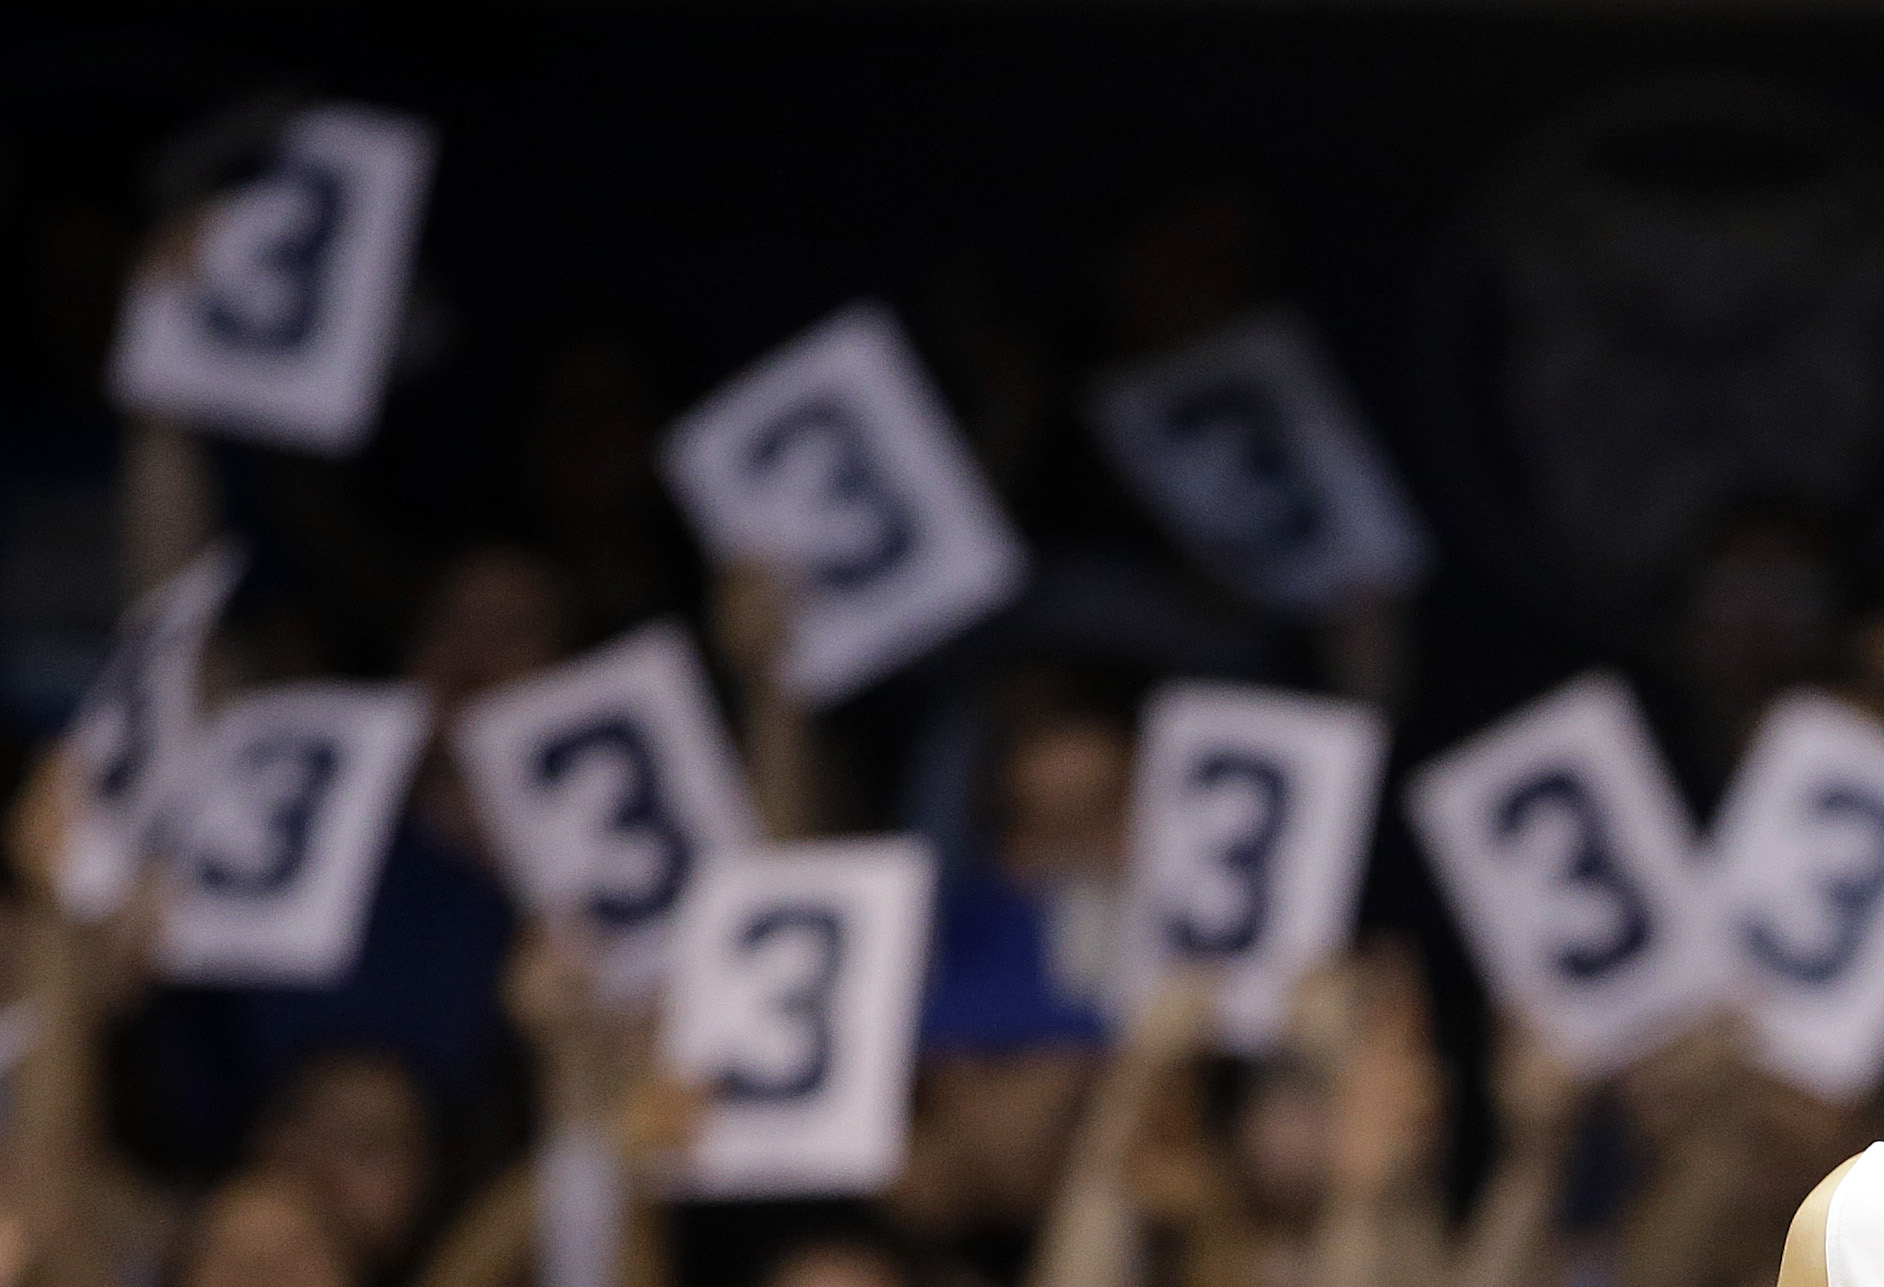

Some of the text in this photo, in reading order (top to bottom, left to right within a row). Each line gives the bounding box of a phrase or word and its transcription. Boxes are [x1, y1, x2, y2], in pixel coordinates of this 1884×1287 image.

[192, 155, 345, 357] 3
[742, 400, 922, 592] 3
[1158, 377, 1330, 558] 3
[195, 735, 342, 897] 3
[525, 715, 692, 930] 3
[1162, 748, 1292, 955] 3
[1490, 768, 1652, 985] 3
[712, 903, 848, 1106] 3
